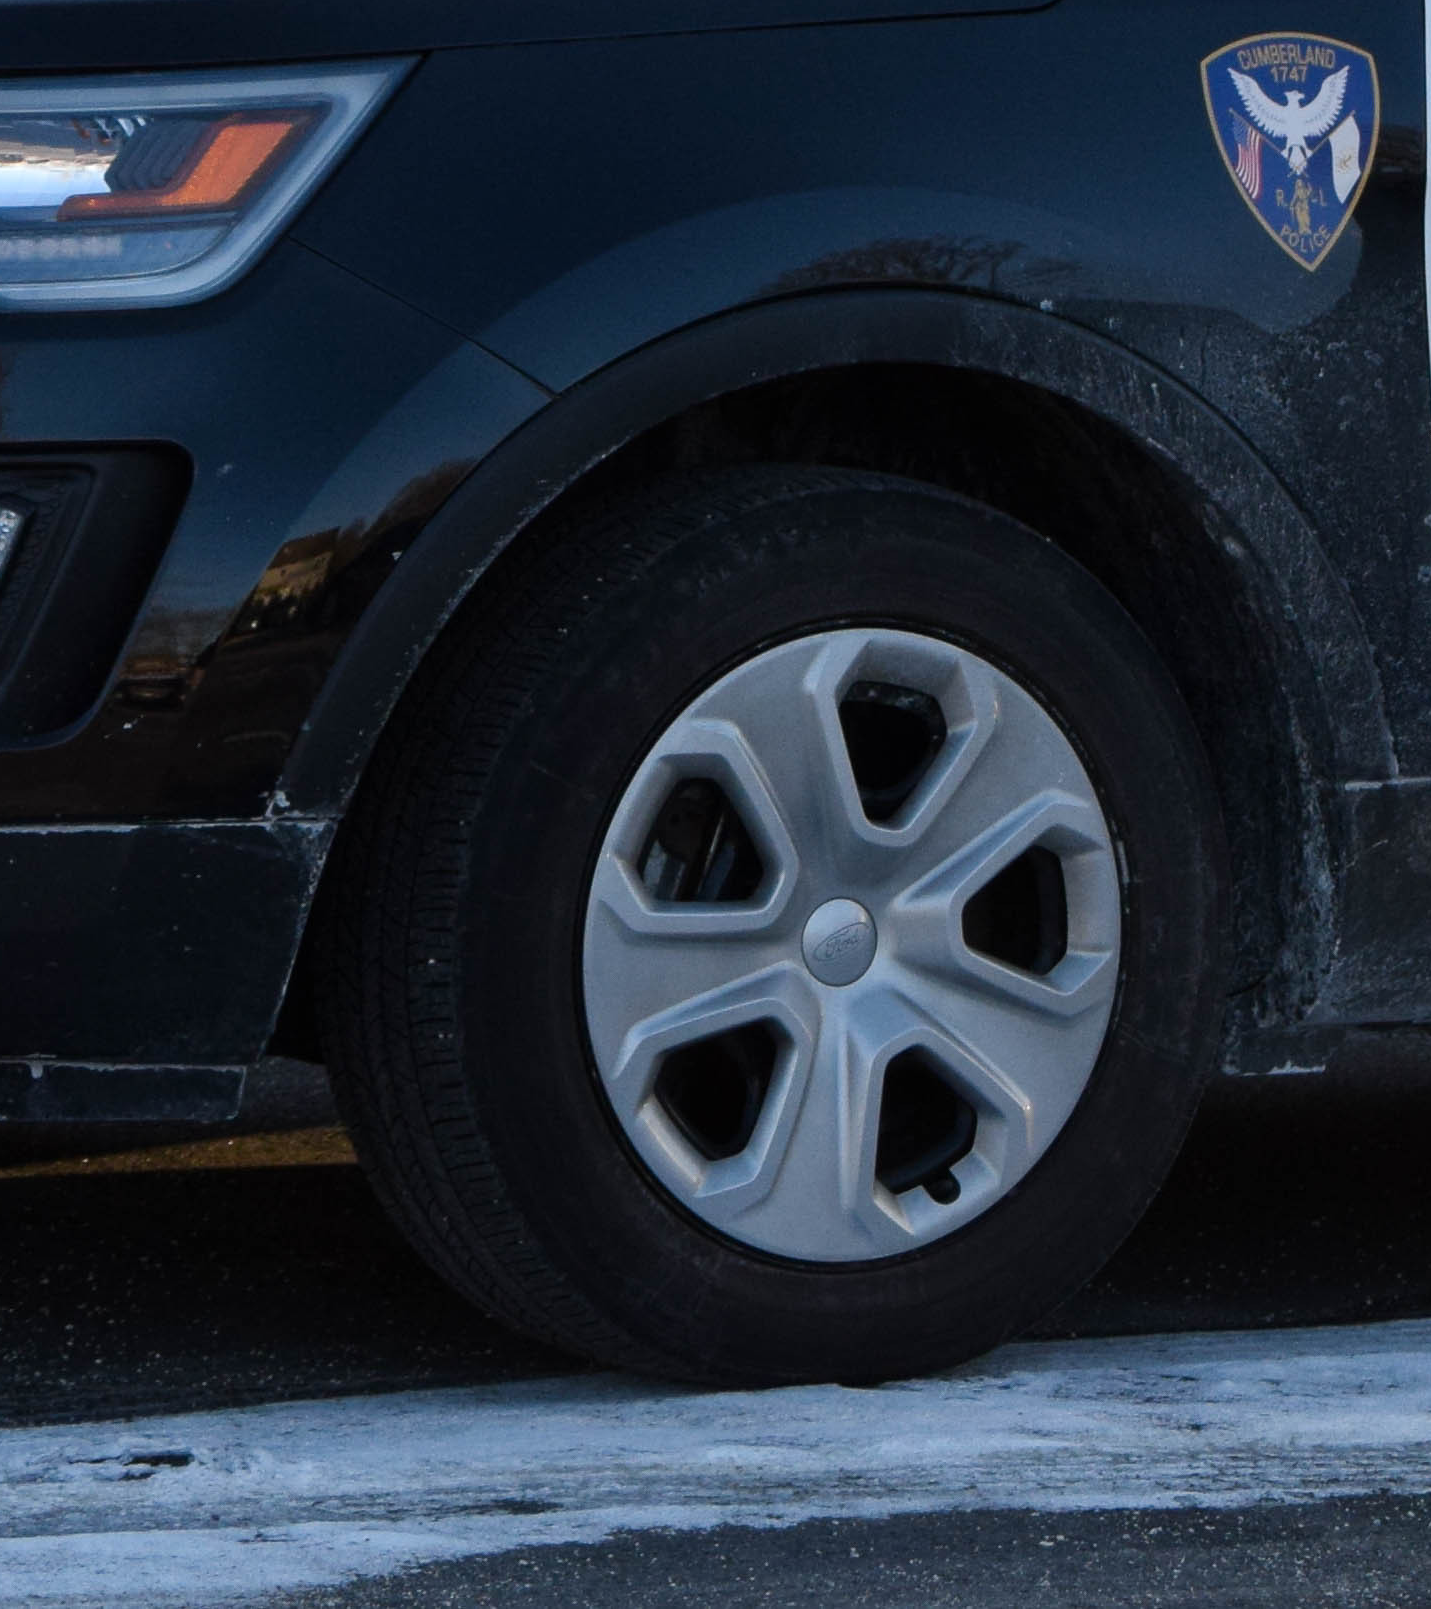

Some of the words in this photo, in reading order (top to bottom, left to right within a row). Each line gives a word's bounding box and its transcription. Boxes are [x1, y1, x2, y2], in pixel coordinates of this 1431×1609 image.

[1237, 43, 1336, 71] CUMBERLAND
[1269, 65, 1309, 84] 1747
[1280, 222, 1332, 254] POLICE
